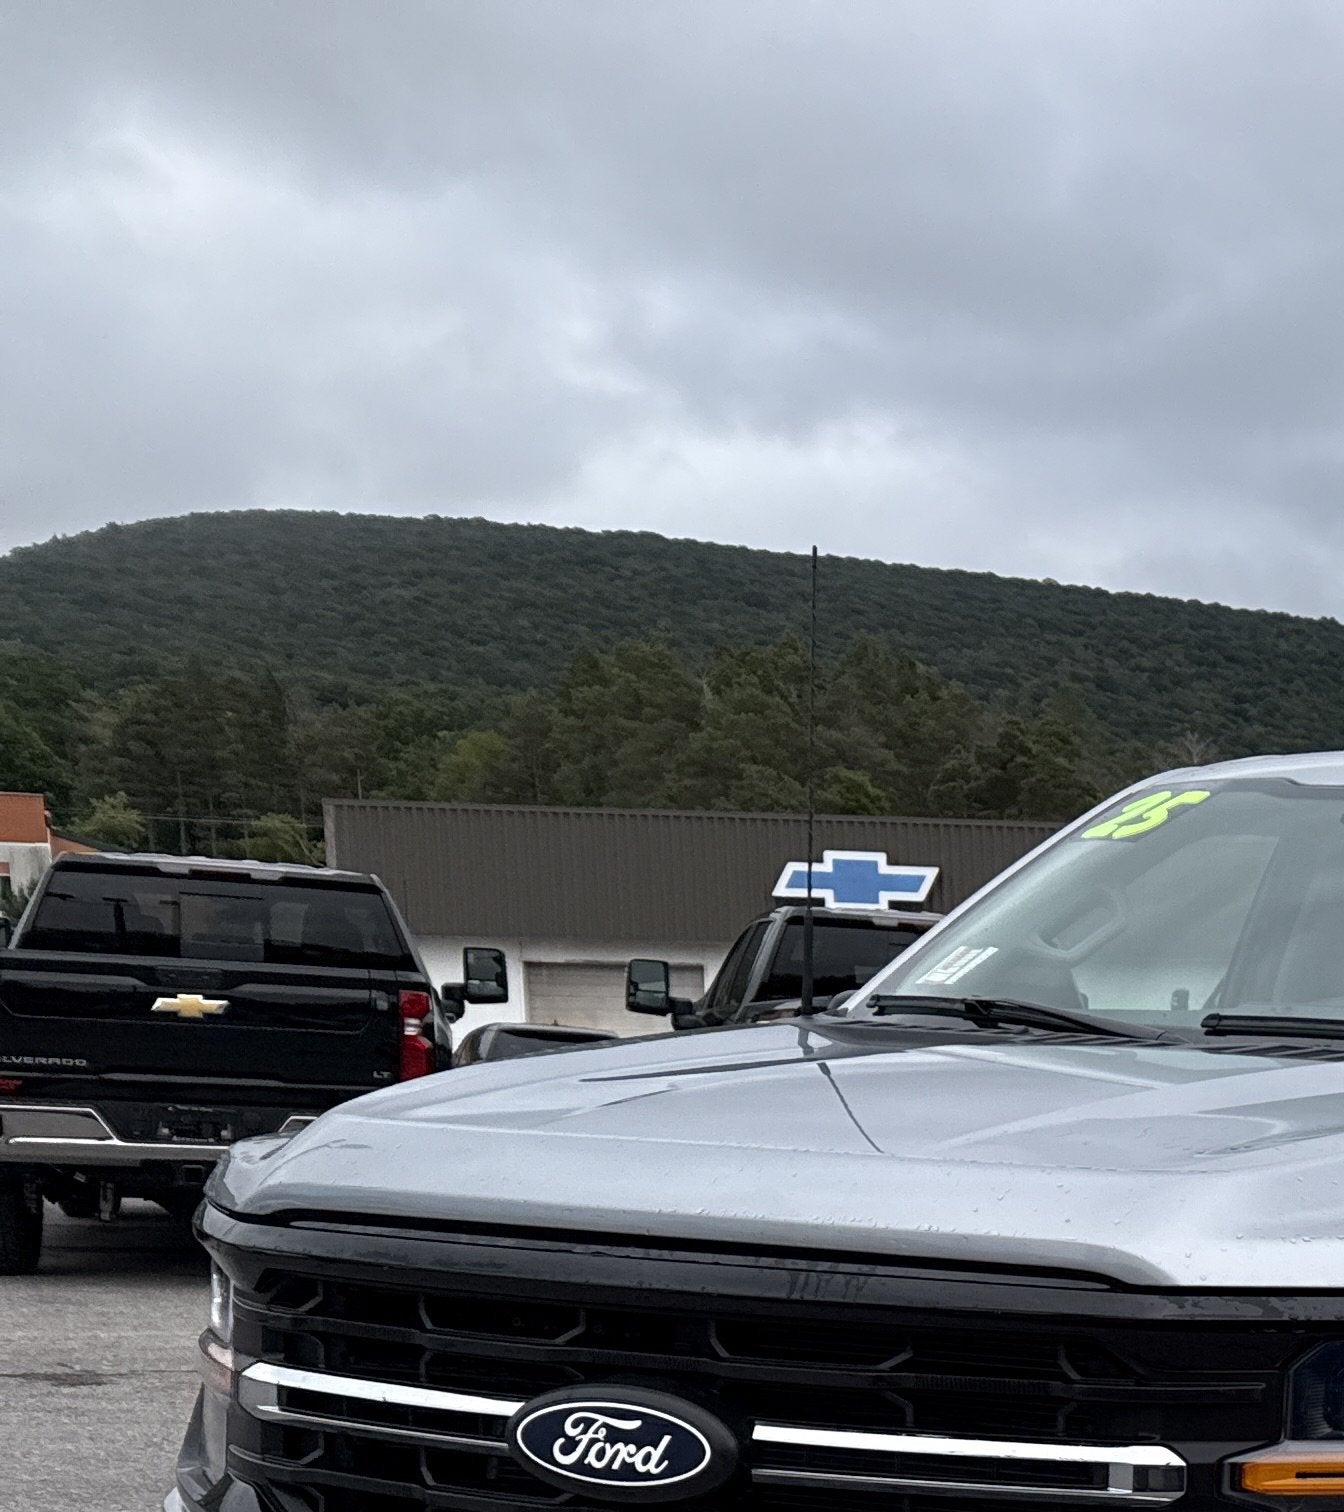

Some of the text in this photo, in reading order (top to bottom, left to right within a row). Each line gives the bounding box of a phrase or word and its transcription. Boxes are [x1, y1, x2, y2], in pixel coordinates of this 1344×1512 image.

[1081, 790, 1211, 840] 25
[0, 1055, 87, 1066] LVERADO
[553, 1411, 672, 1474] Ford
